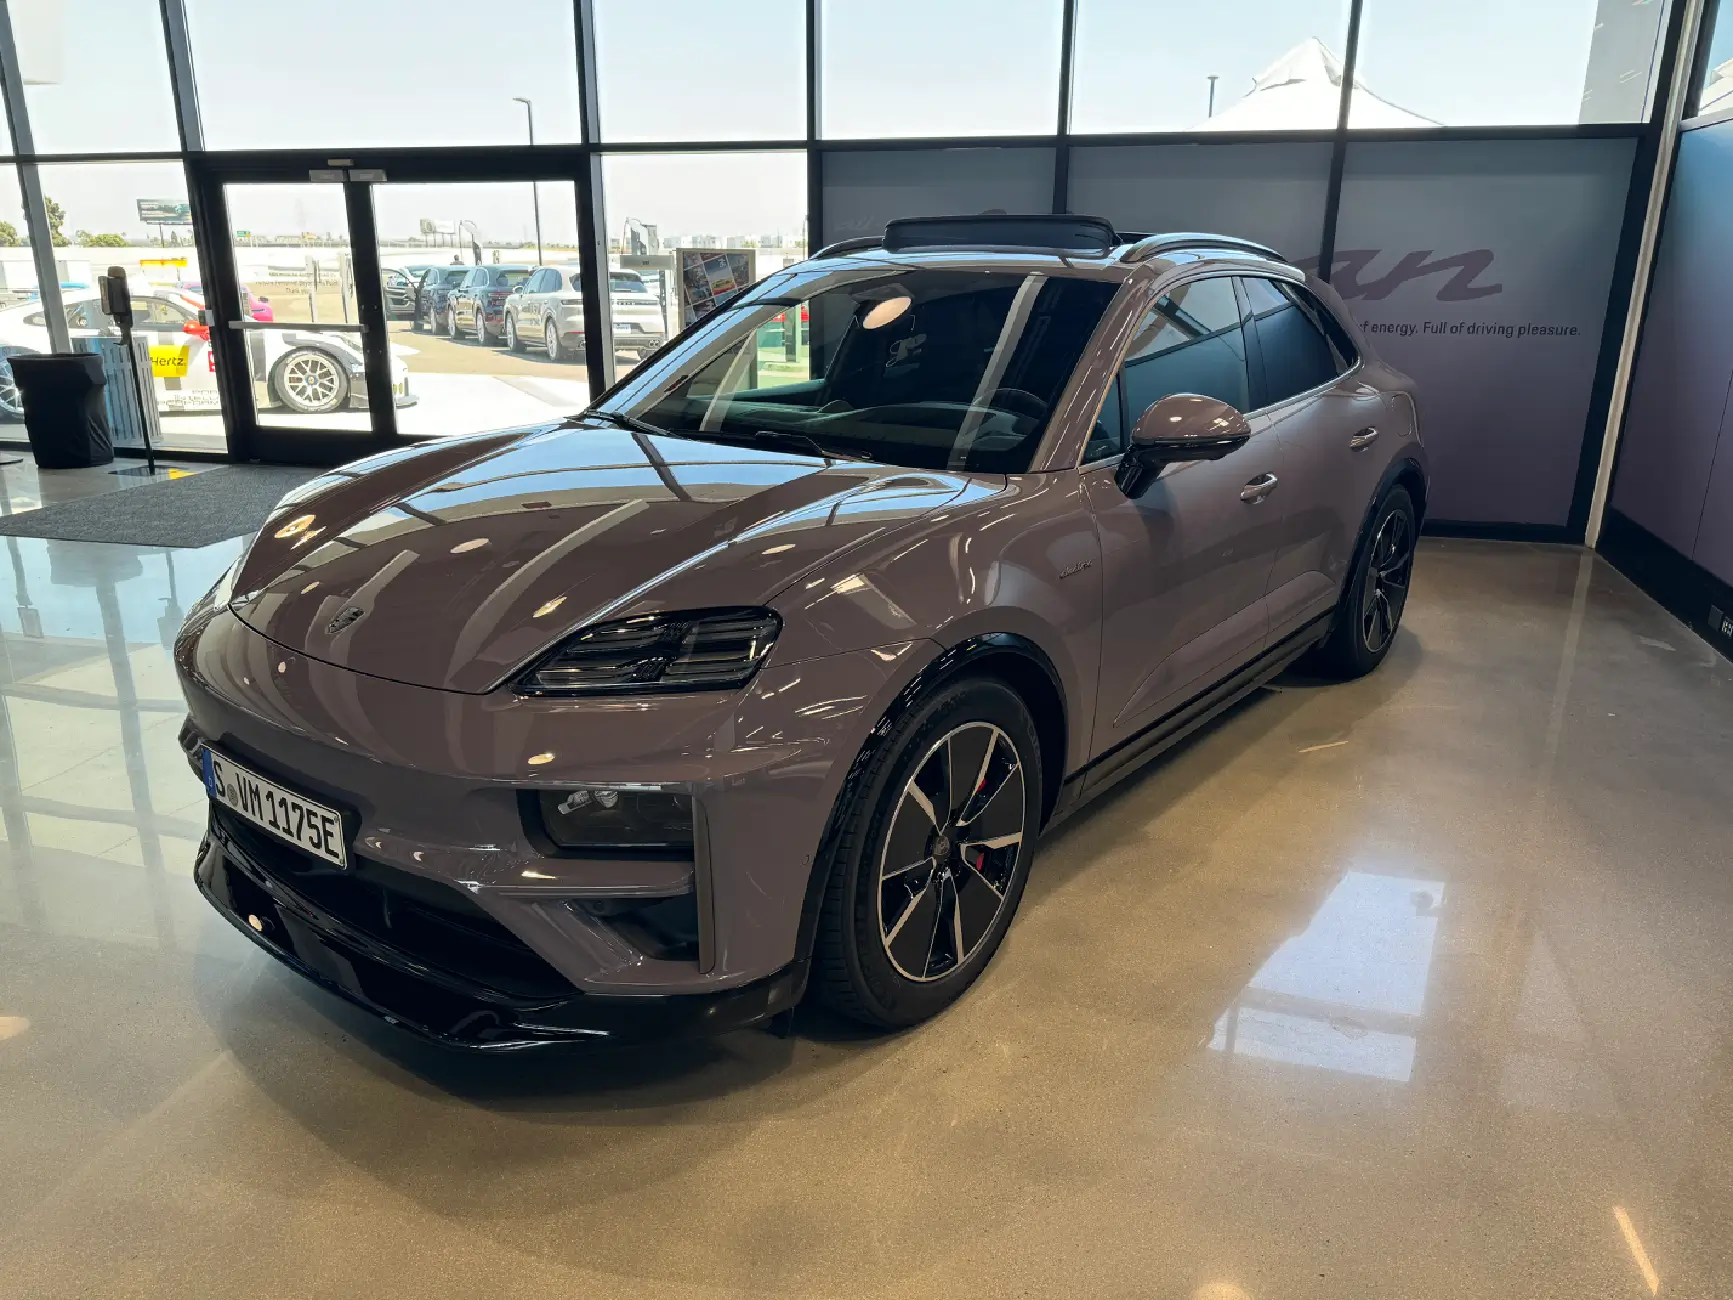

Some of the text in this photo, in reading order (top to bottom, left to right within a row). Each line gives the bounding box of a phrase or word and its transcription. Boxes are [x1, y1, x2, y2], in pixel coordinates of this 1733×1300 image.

[1370, 322, 1419, 338] energy.
[1423, 321, 1448, 335] Full
[1450, 322, 1466, 335] of
[1468, 322, 1515, 339] driving
[1518, 322, 1582, 339] pleasure.
[150, 357, 184, 367] Hertz
[213, 760, 226, 798] S
